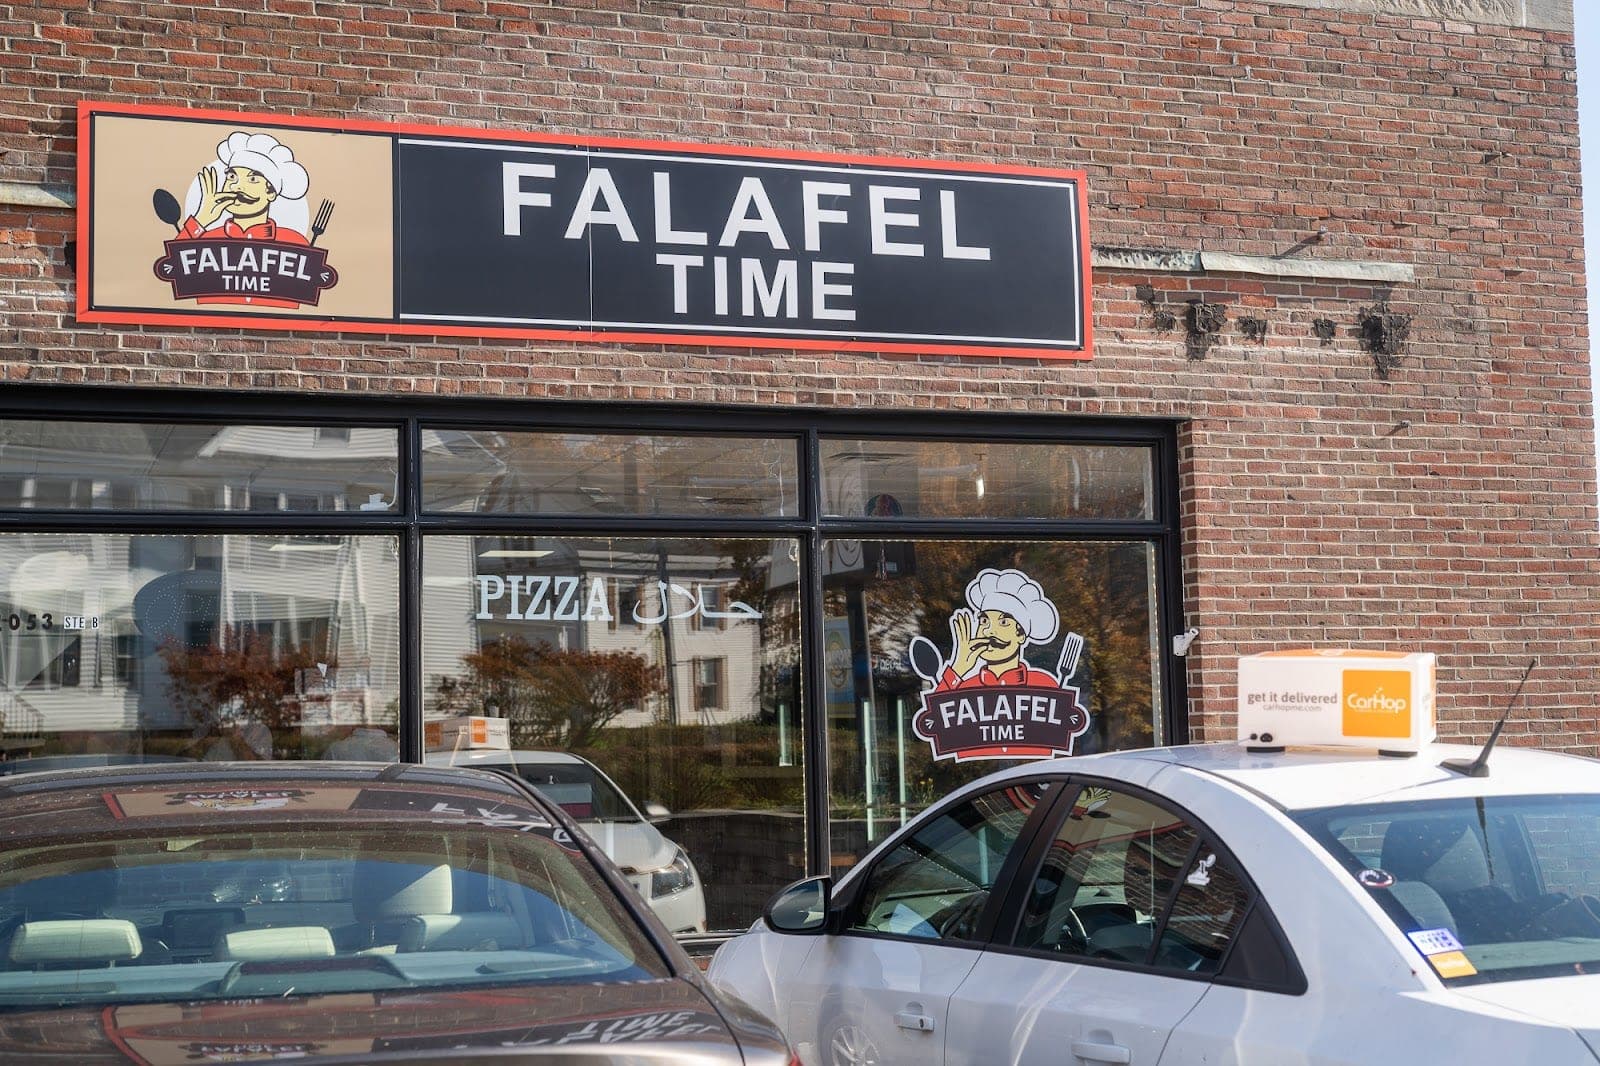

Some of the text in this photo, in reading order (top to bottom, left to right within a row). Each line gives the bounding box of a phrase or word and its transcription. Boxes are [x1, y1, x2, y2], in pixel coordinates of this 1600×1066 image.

[502, 161, 991, 261] FALAFEL
[179, 246, 312, 281] FALAFEL
[221, 275, 271, 292] TIME
[655, 253, 857, 321] TIME
[476, 574, 614, 622] PIZZA
[632, 580, 763, 624] حلال
[0, 613, 98, 630] 053 STE B
[939, 694, 1062, 729] FALAFEL
[1247, 692, 1338, 704] get it delivered
[1347, 692, 1406, 714] CarHop
[979, 724, 1025, 741] TIME
